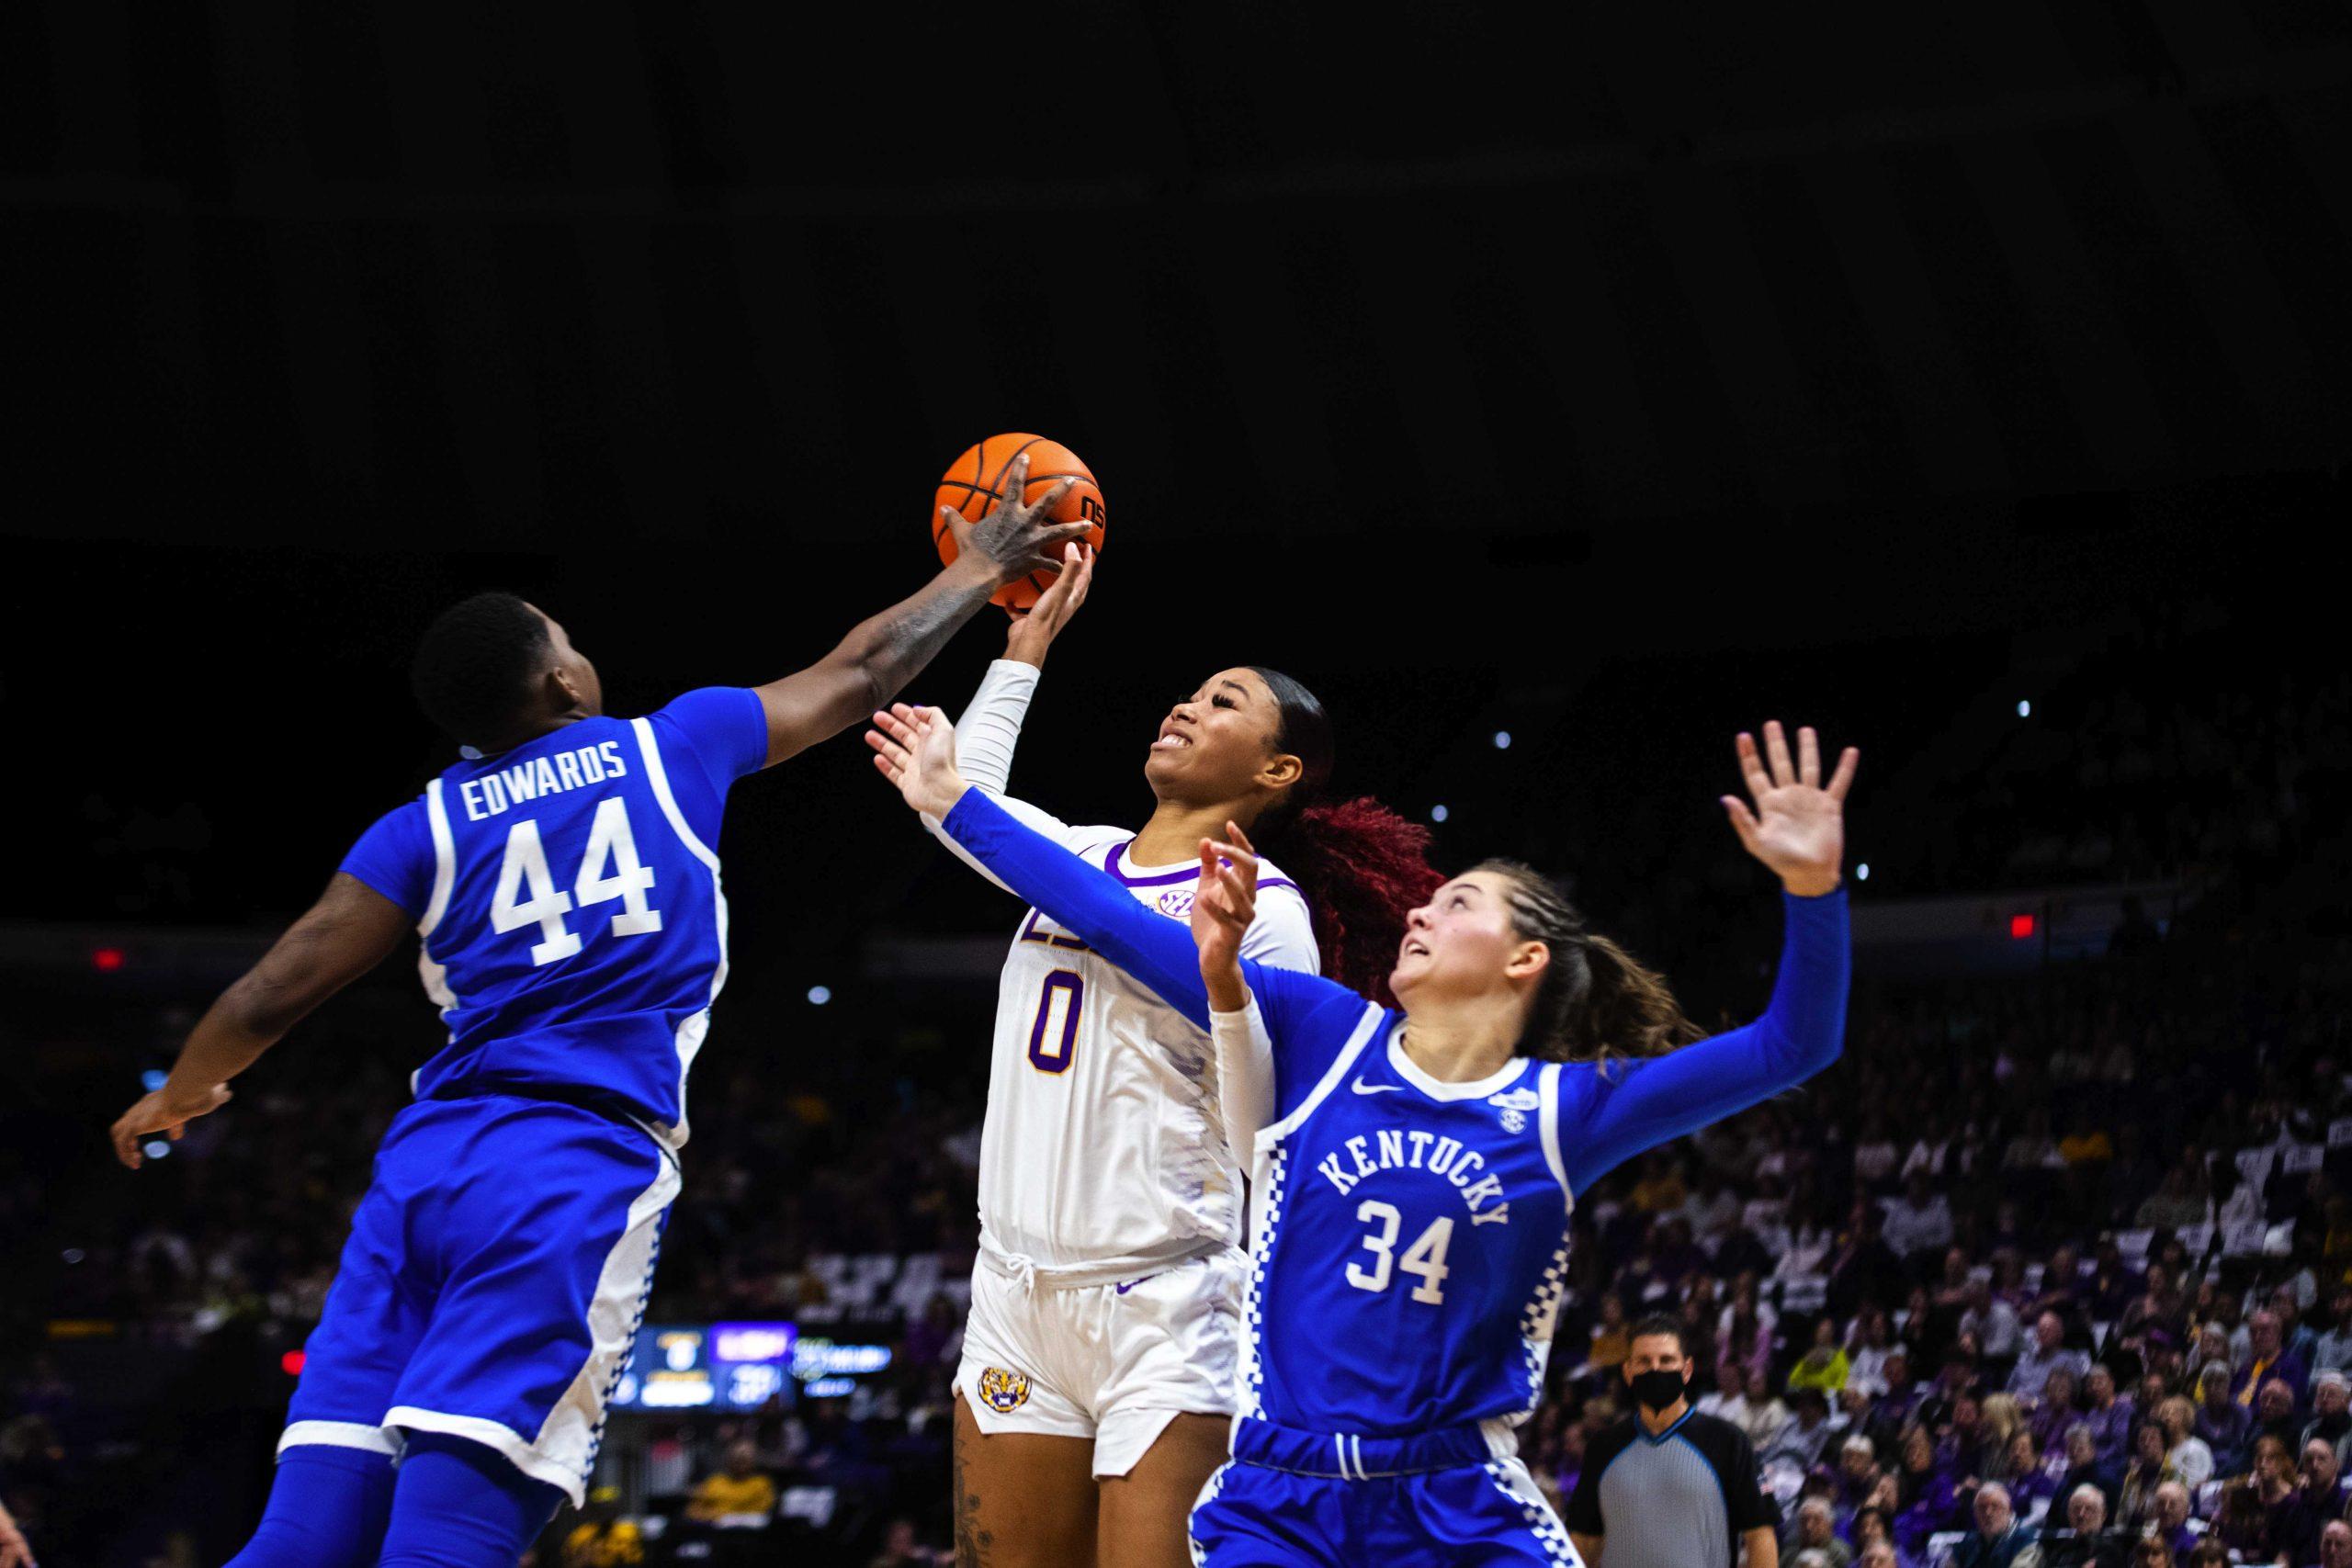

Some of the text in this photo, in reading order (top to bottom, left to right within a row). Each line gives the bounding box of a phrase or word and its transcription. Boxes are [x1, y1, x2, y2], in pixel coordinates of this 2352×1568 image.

[459, 740, 628, 821] EDWARDS
[489, 795, 662, 967] 44
[1028, 967, 1084, 1076] 0
[1317, 1130, 1510, 1226] KENTUCKY
[1344, 1199, 1454, 1305] 34
